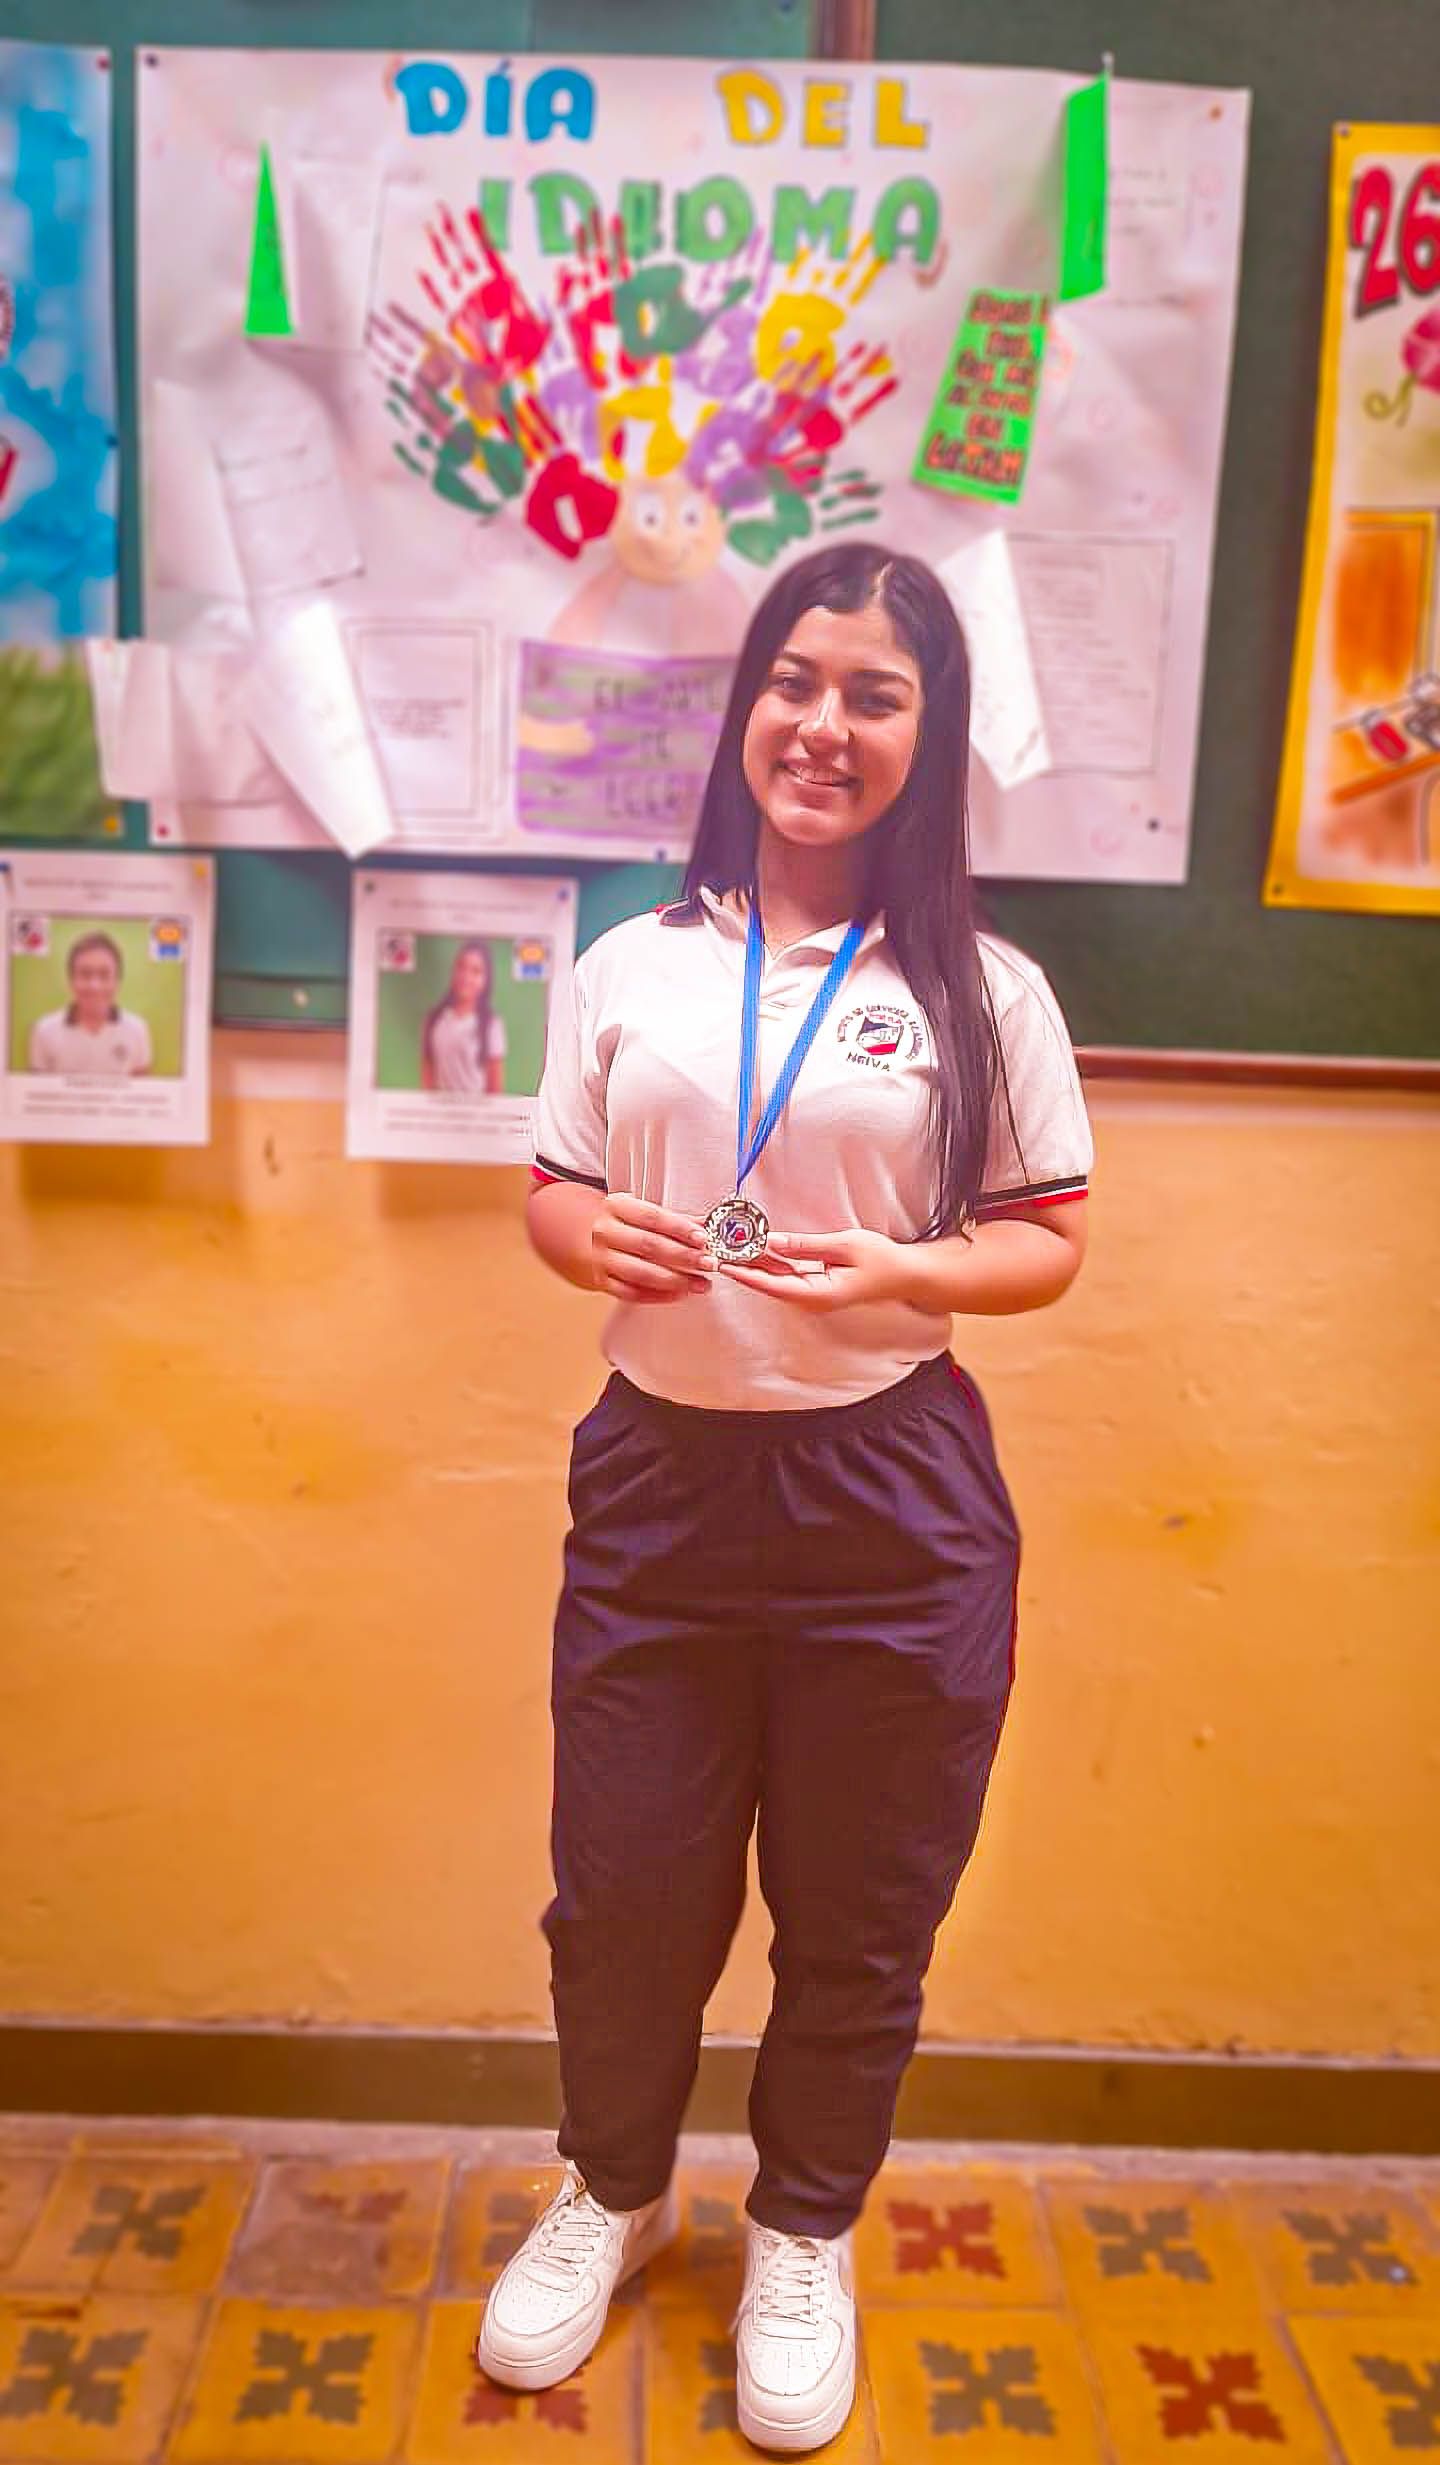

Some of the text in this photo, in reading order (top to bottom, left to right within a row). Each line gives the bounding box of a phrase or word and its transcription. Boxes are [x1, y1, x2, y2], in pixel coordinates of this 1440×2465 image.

[394, 60, 930, 149] DÍA DEL
[477, 170, 942, 268] IDIOMA
[1348, 164, 1440, 319] 26
